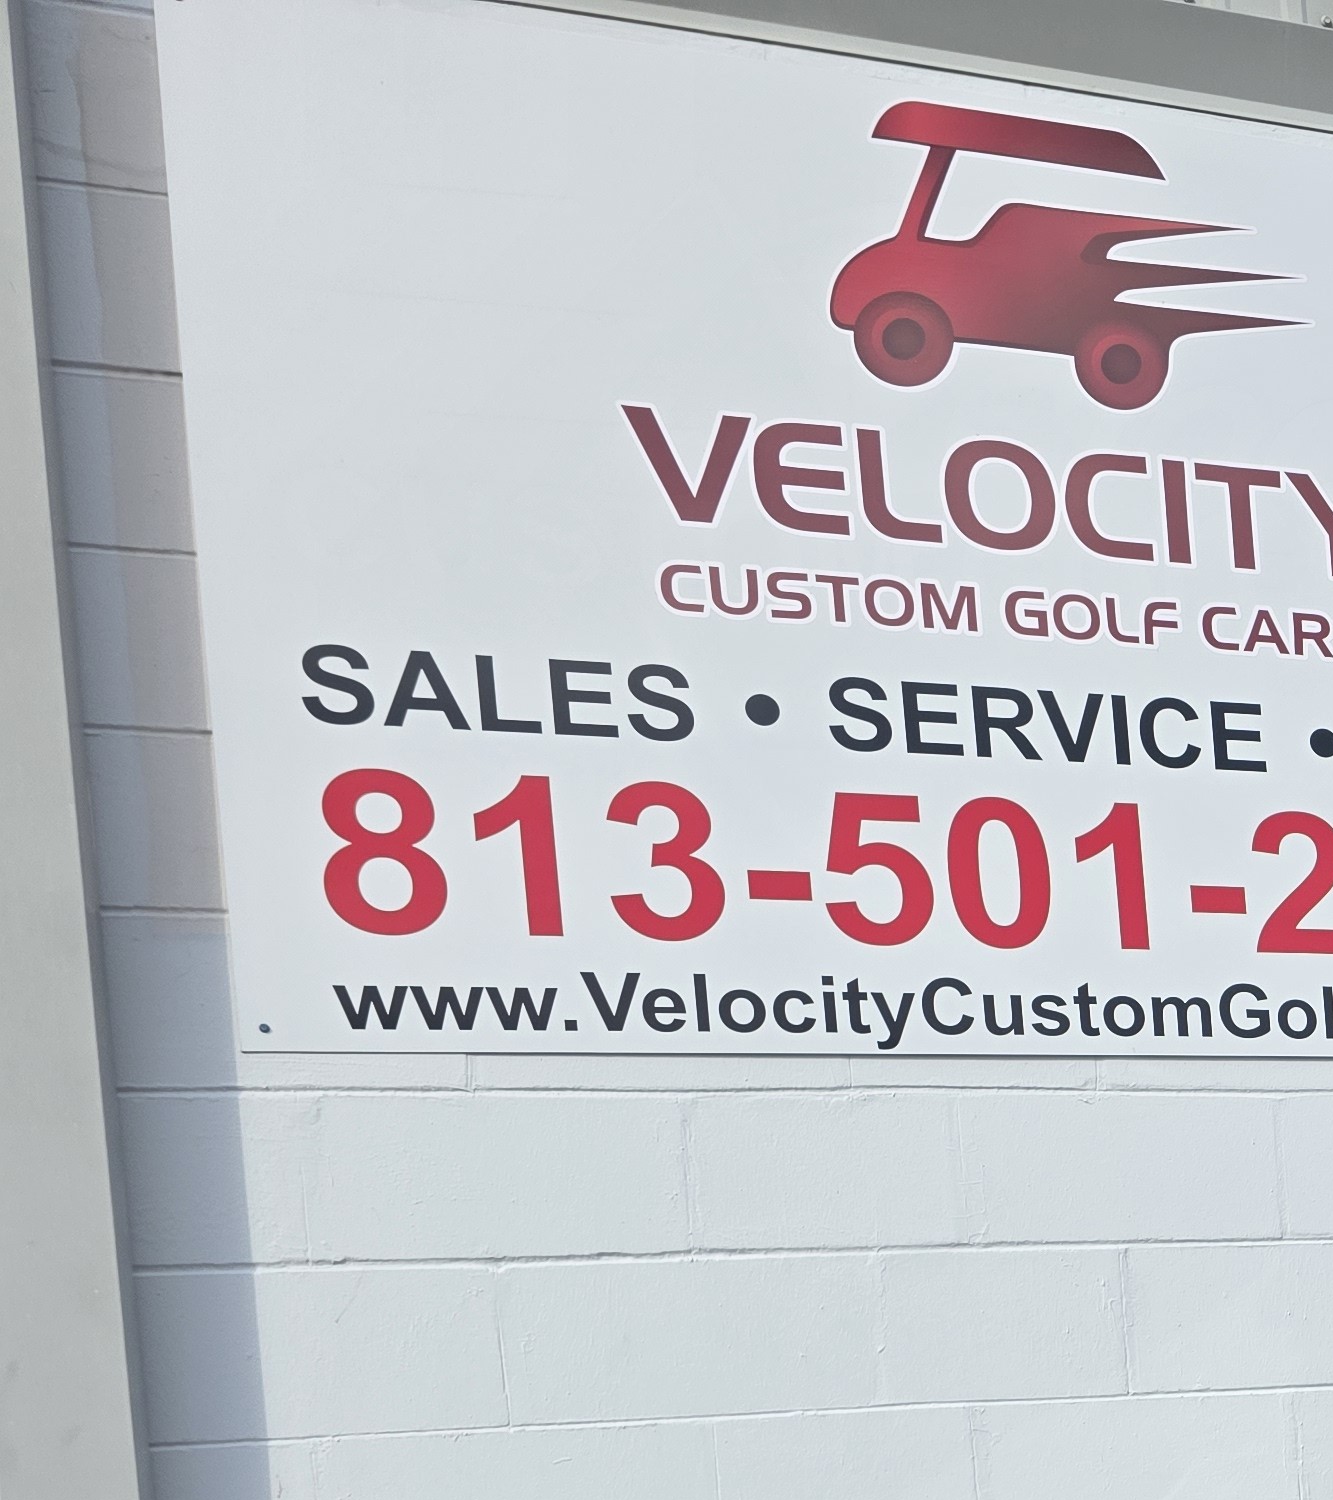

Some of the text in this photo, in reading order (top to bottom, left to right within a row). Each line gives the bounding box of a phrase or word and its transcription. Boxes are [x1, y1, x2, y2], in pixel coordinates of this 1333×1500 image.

[660, 564, 978, 632] CUSTOM
[1004, 590, 1179, 645] GOLF
[302, 644, 694, 742] SALES
[829, 677, 1268, 773] SERVICE
